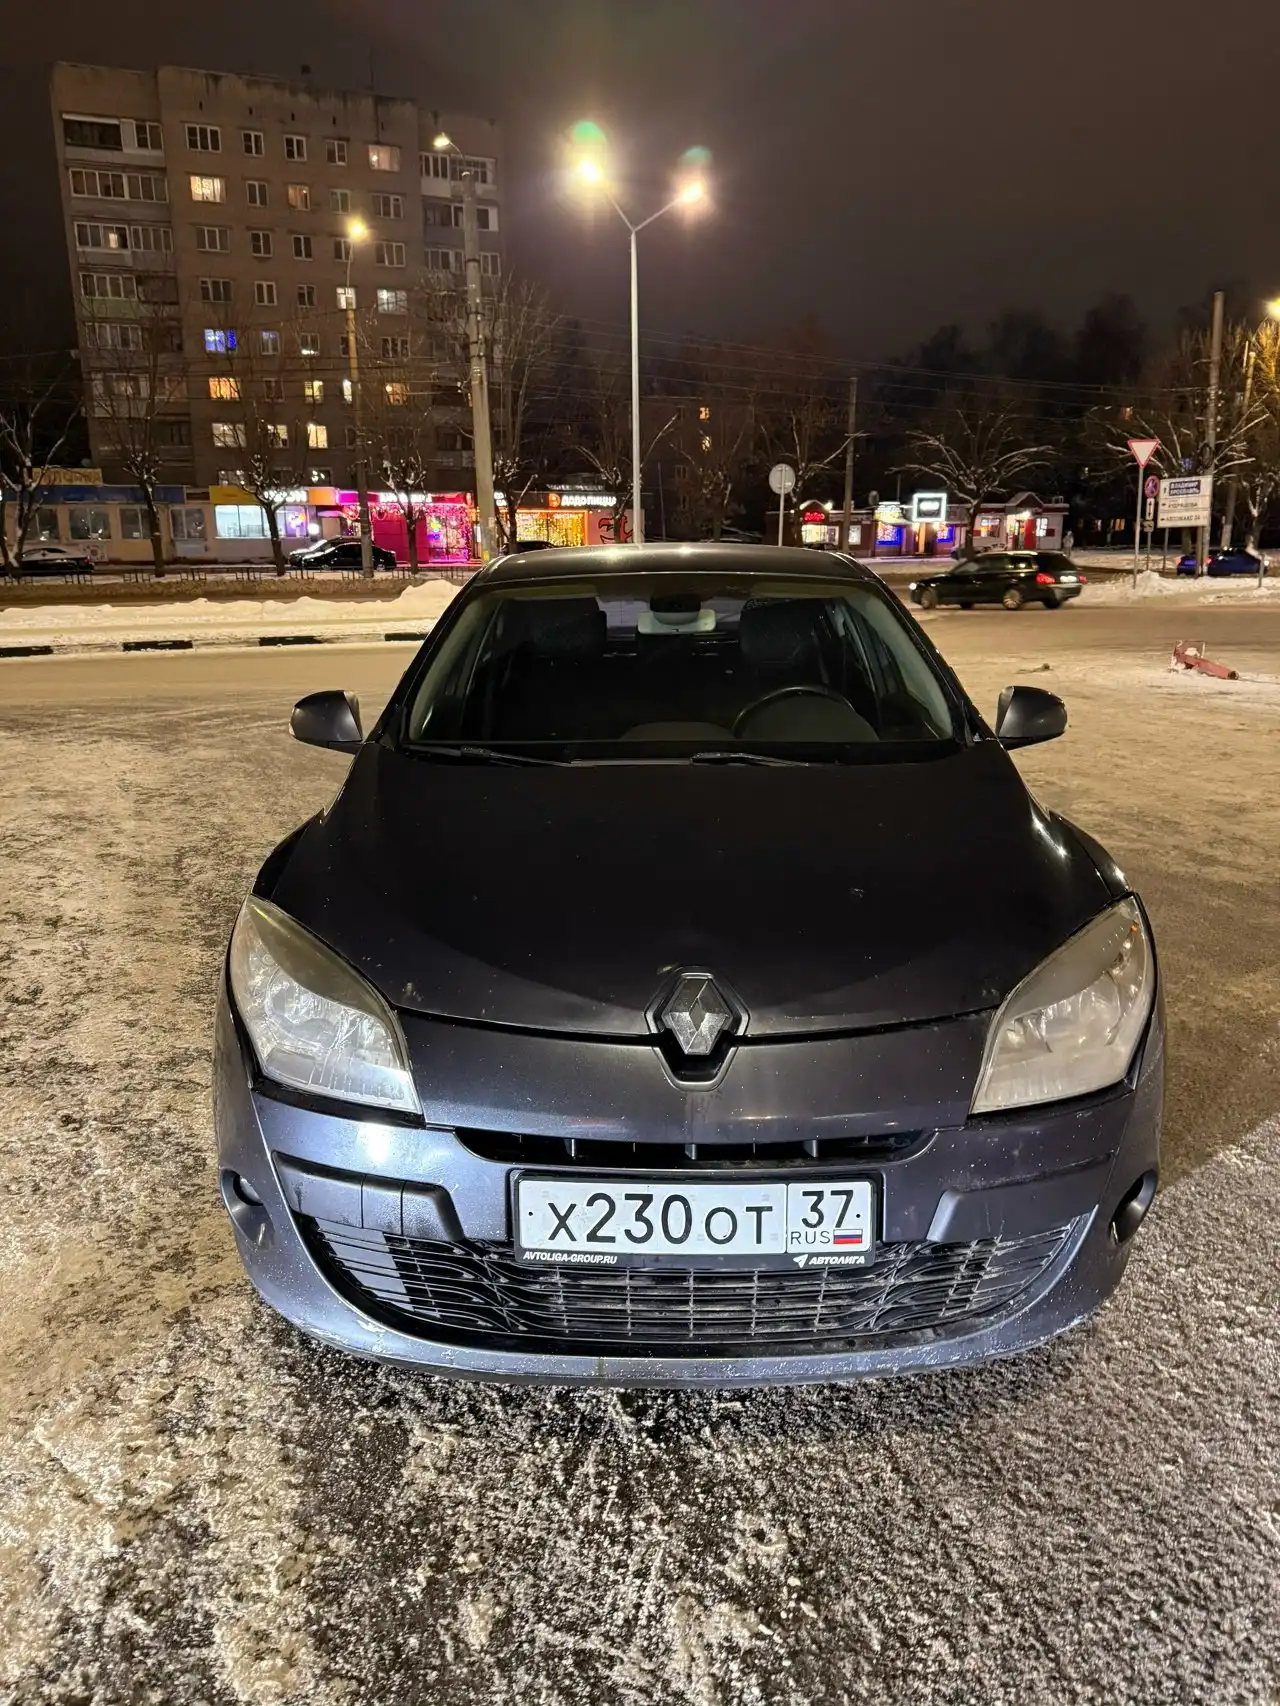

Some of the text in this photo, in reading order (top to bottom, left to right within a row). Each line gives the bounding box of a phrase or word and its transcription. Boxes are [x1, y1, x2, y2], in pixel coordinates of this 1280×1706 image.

[548, 1189, 854, 1245] Х230ОТ 37
[790, 1230, 831, 1245] RUS
[522, 1251, 618, 1264] AVTOLIGA-GROUP.RU
[808, 1255, 865, 1265] АВТОЛИГА
